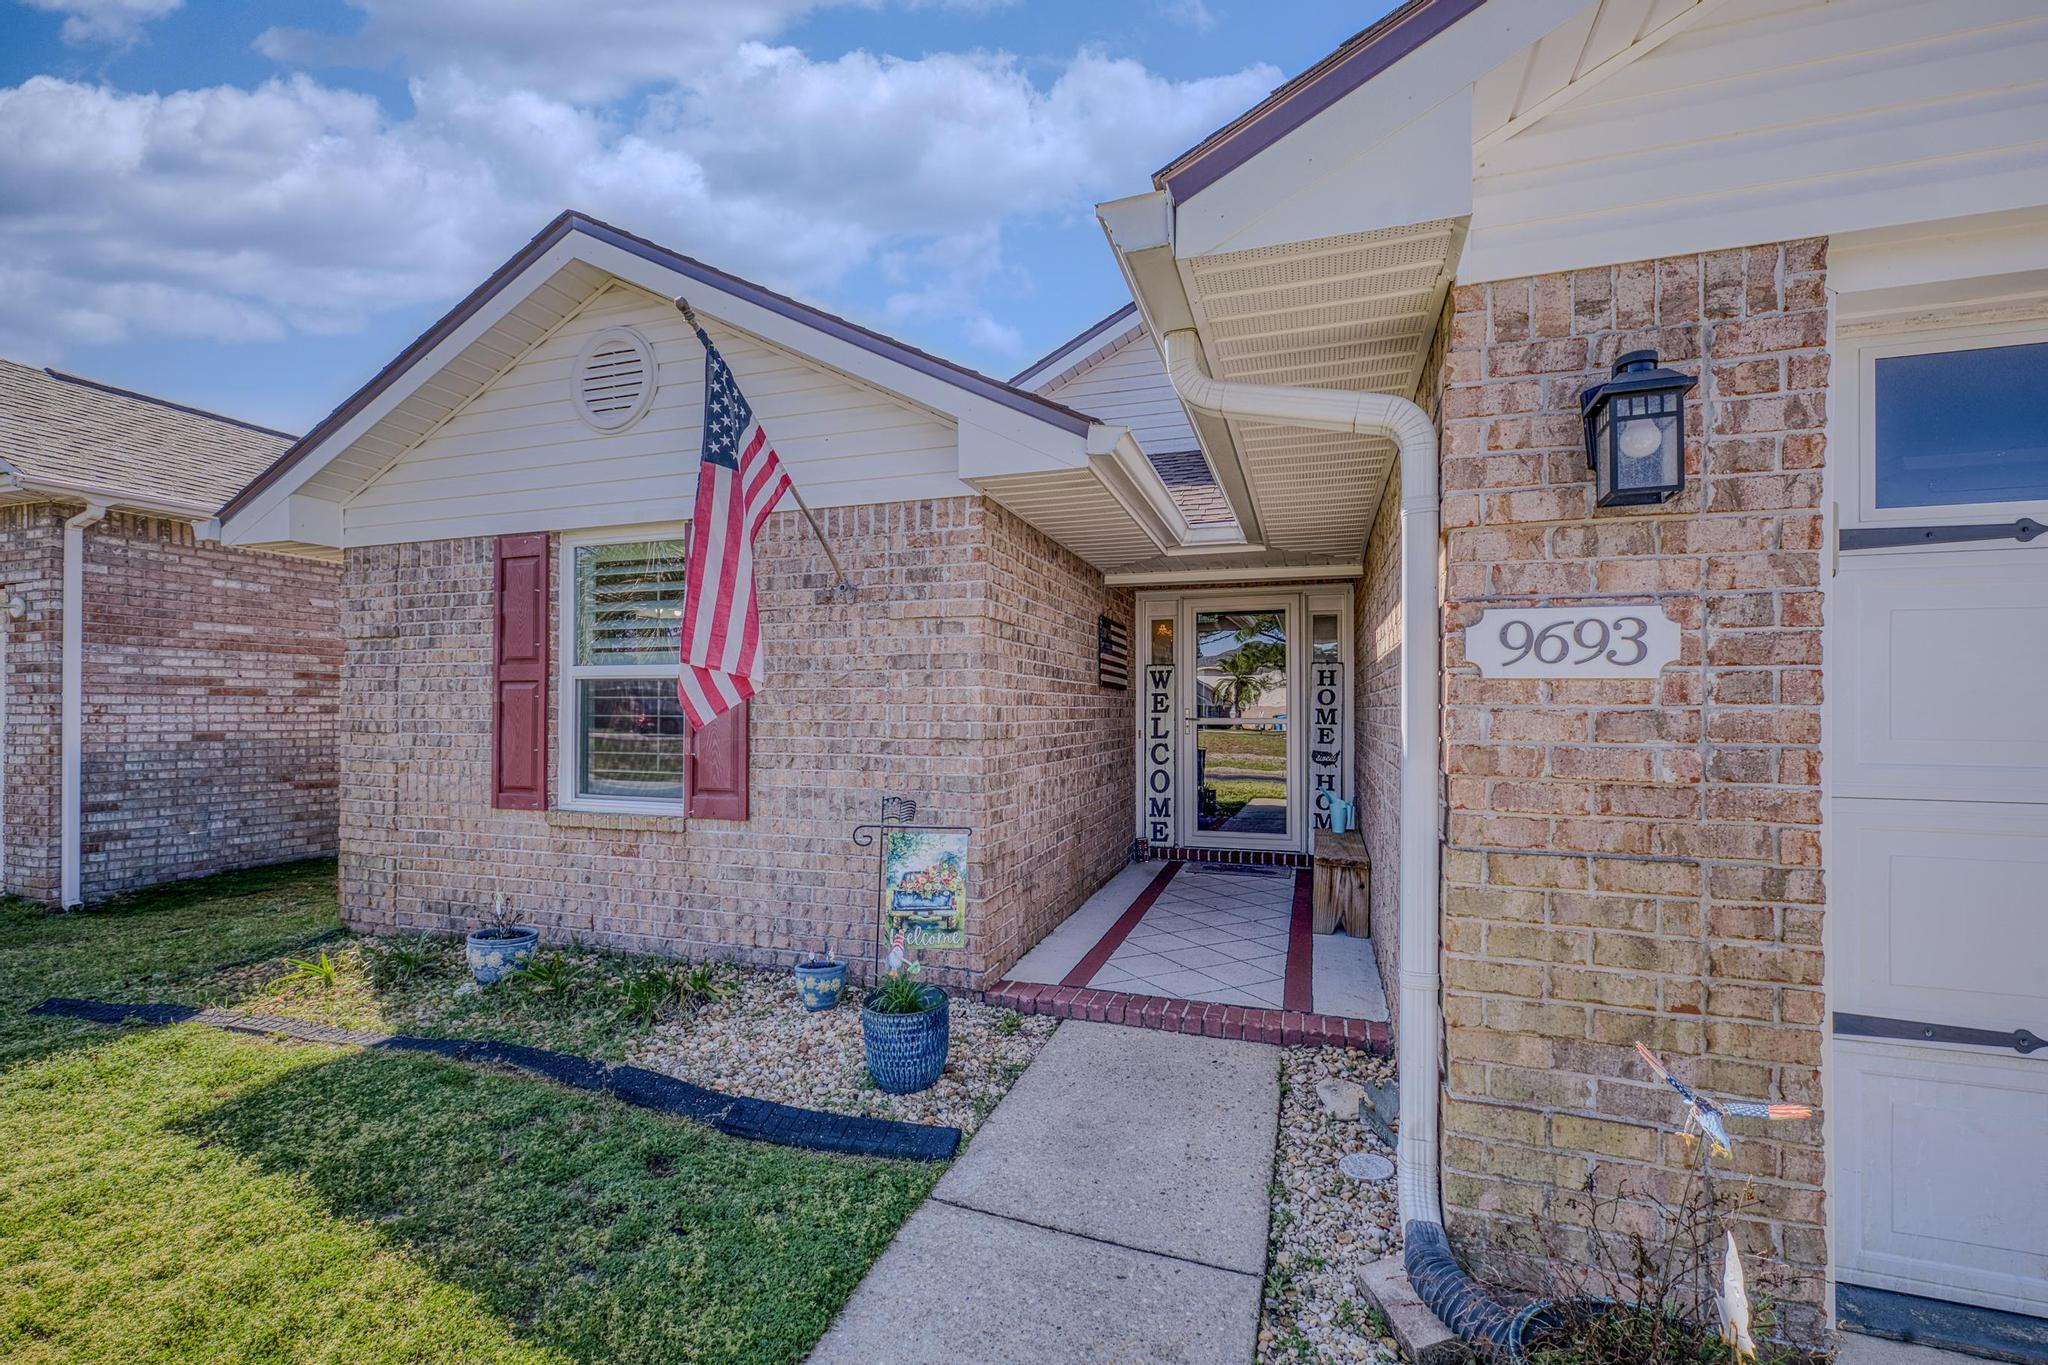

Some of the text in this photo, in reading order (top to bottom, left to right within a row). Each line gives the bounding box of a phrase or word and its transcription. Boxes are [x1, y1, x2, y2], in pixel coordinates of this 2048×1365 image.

[1499, 617, 1648, 667] 9693
[1315, 669, 1338, 744] HOME
[1149, 670, 1172, 842] WELCOME
[1313, 774, 1335, 829] HOM
